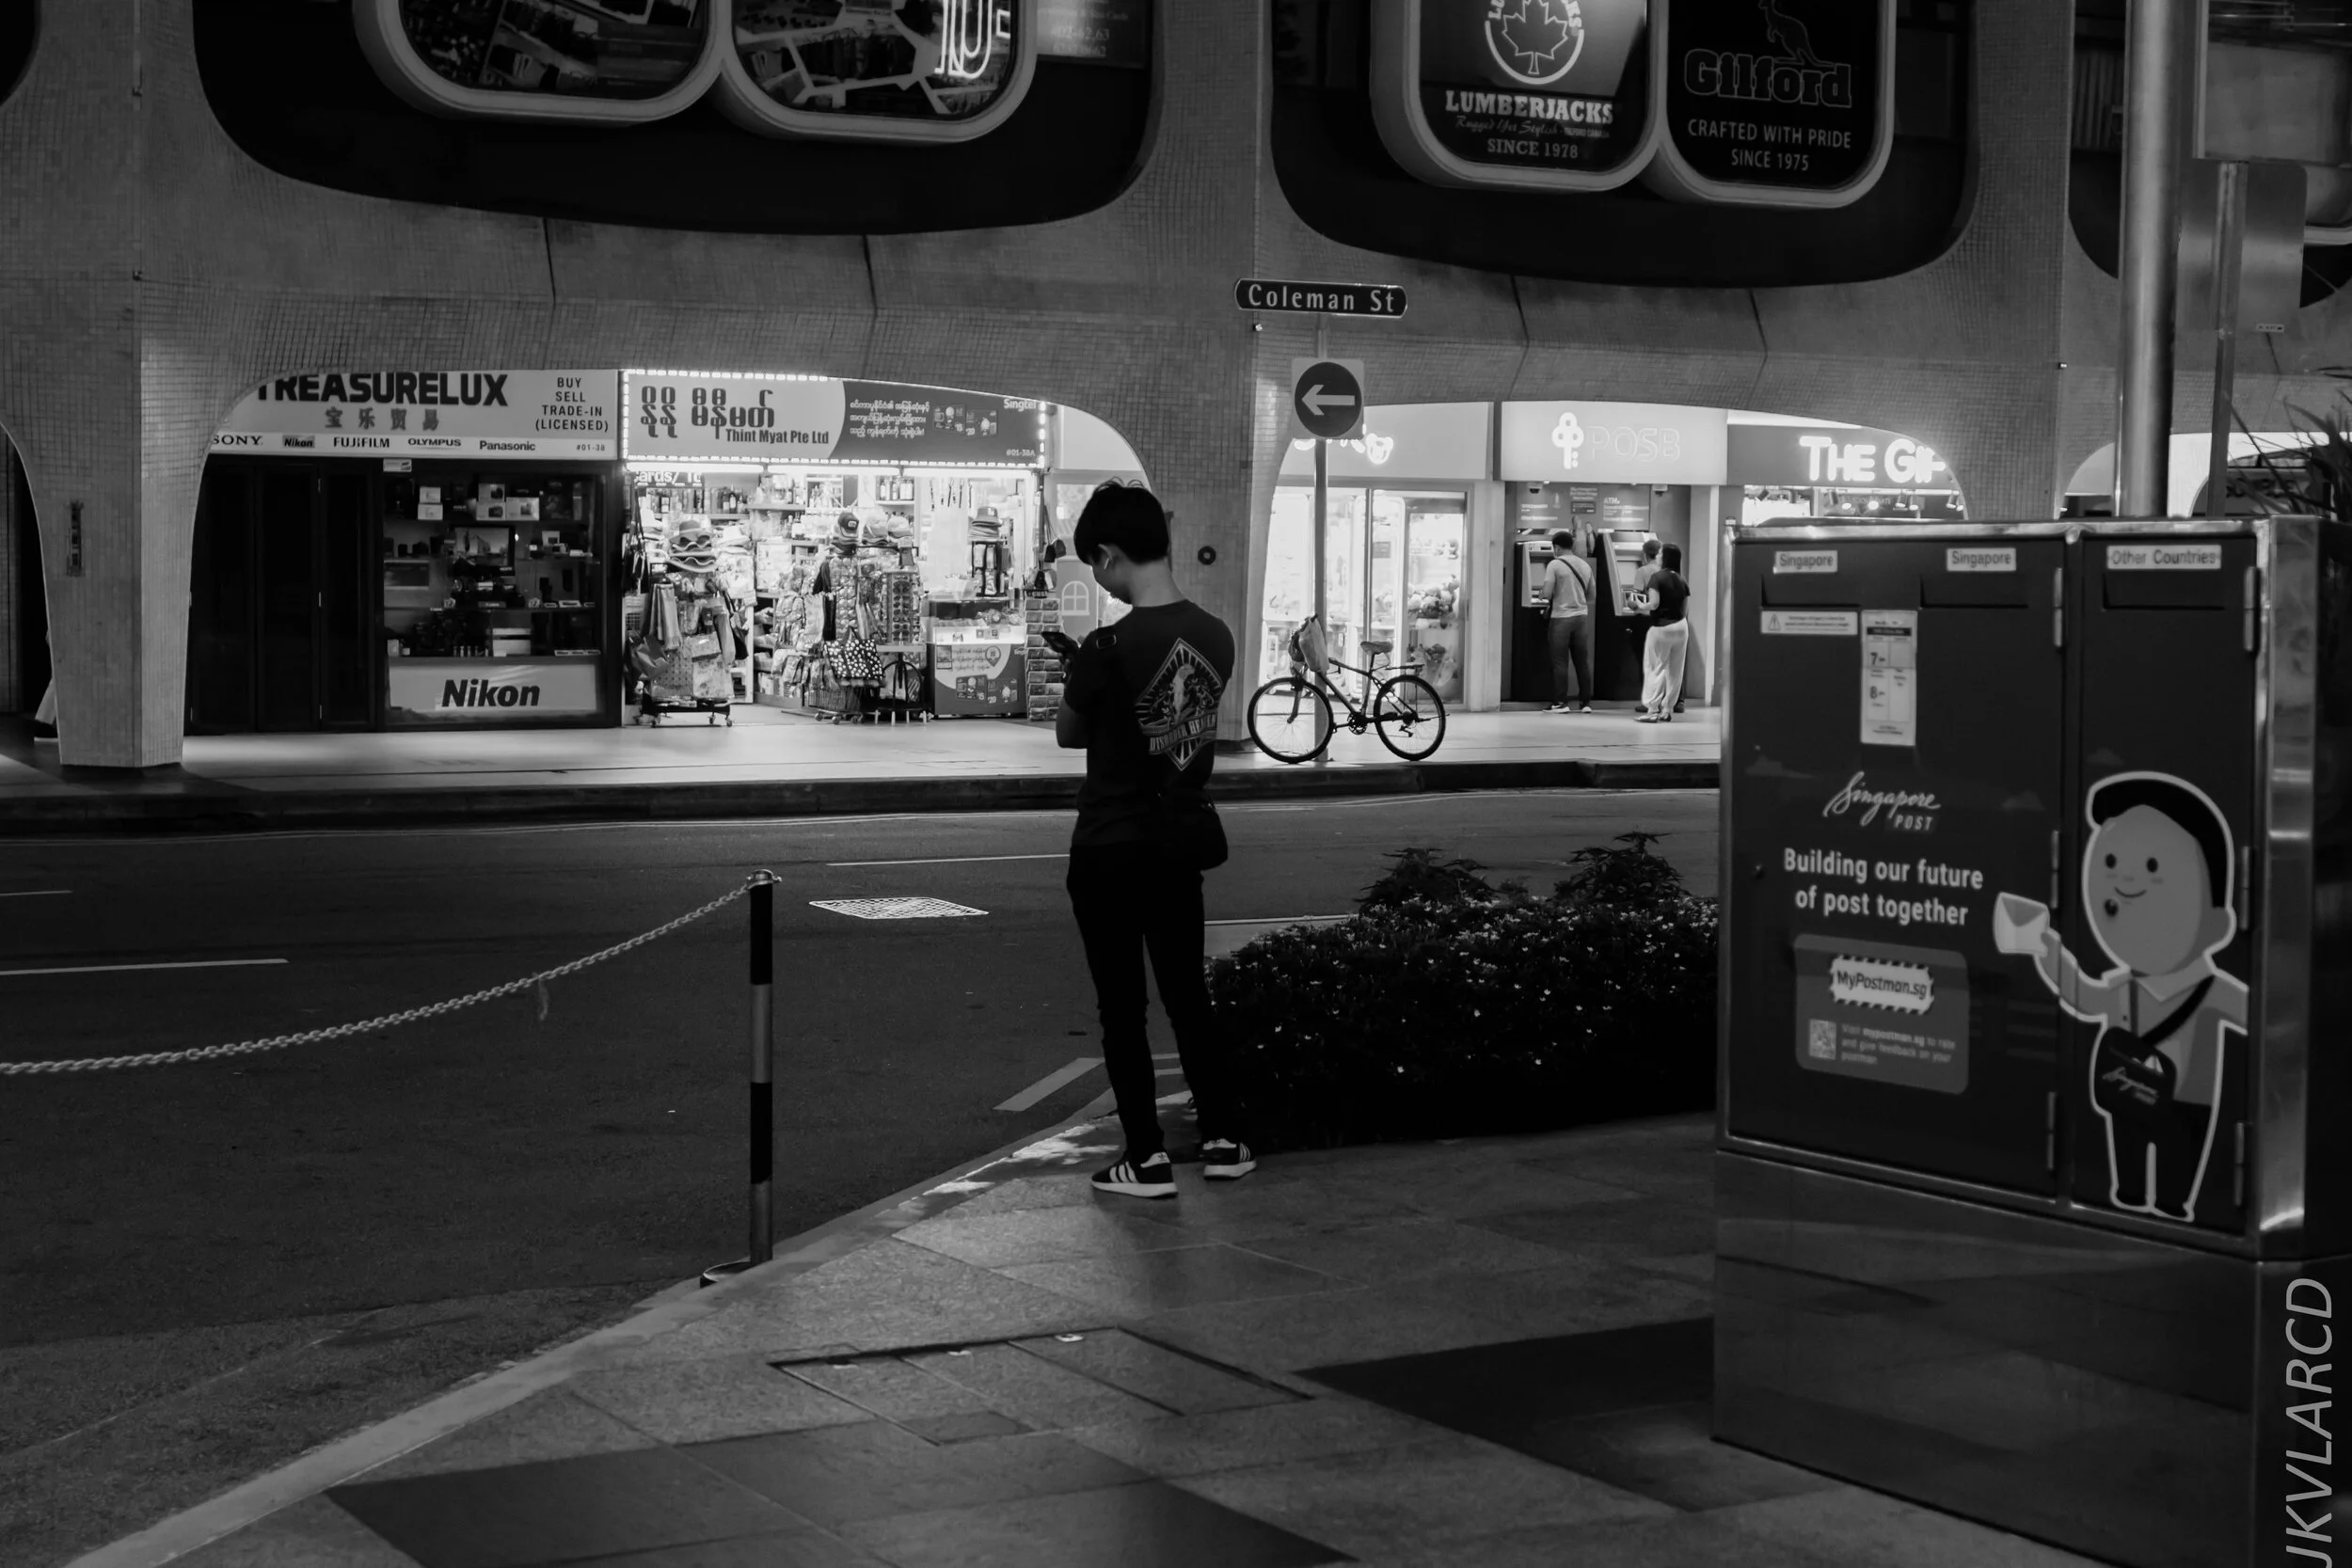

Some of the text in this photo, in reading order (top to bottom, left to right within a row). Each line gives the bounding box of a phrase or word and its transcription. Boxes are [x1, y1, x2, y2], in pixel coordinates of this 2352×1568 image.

[1684, 48, 1851, 108] Gilford
[1445, 90, 1614, 125] LUMBERJACKS
[1687, 119, 1852, 150] CRAFTED WITH PRIDE
[1486, 138, 1579, 160] SINCE 1978
[1731, 148, 1810, 171] SINCE 1975
[1248, 284, 1394, 313] Coleman St
[556, 377, 581, 388] BUY
[555, 391, 586, 403] SELL
[1004, 398, 1038, 412] Singtel
[541, 404, 603, 417] TRADE-IN
[535, 419, 610, 434] (LICENSED)
[283, 437, 316, 449] Nikon
[333, 436, 391, 449] FUJIFILM
[407, 437, 463, 448] OLYMPUS
[479, 440, 537, 452] Panasonic
[725, 428, 829, 445] Thint Myat Pte Ltd
[1585, 425, 1682, 463] POSB
[1799, 436, 1876, 483] THE
[1780, 553, 1835, 570] Singapore
[1951, 549, 2011, 568] Singapore
[2112, 548, 2217, 565] Other Countries
[442, 678, 540, 707] Nikon
[1821, 771, 1942, 828] Singapore
[1893, 814, 1933, 832] POST
[1784, 847, 1984, 891] Building our future
[1794, 884, 1970, 927] of post together
[1836, 970, 1929, 1002] MyPostman.sg
